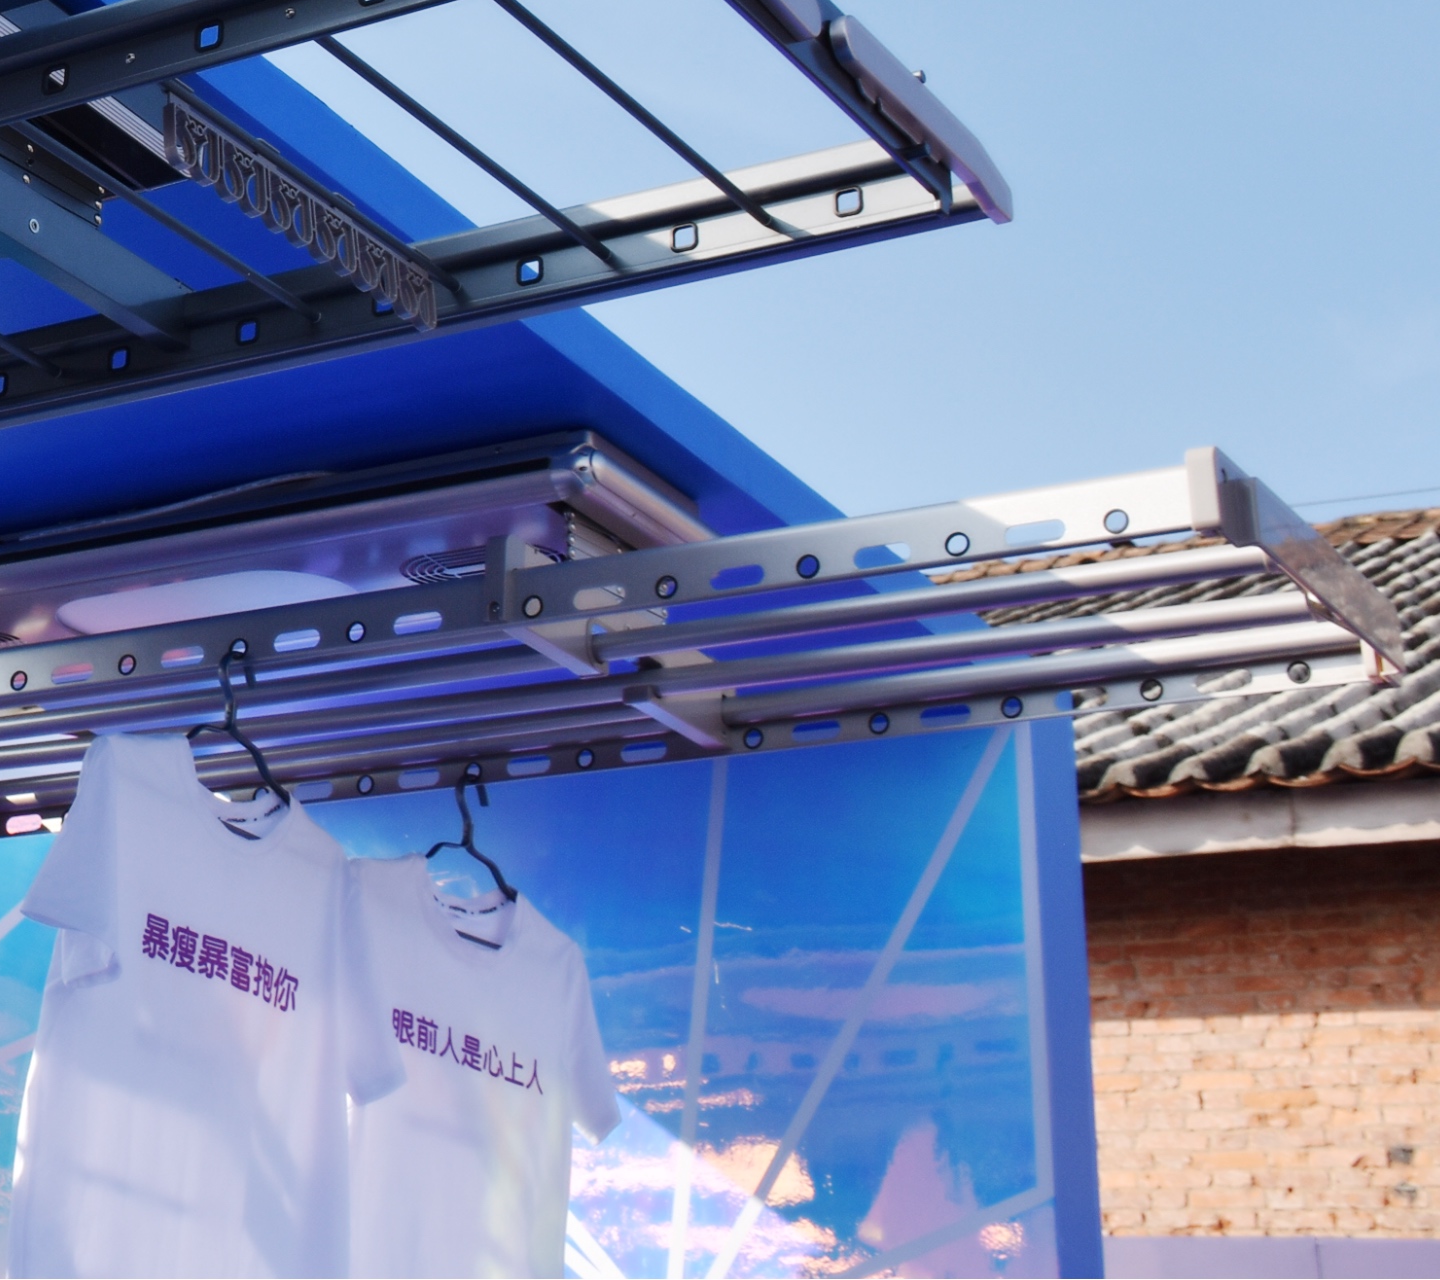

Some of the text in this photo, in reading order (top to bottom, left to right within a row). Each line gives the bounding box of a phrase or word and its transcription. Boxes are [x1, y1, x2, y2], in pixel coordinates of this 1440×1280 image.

[142, 913, 299, 1013] 暴瘦暴富抱你
[392, 1008, 544, 1095] 眼前人是心上人
